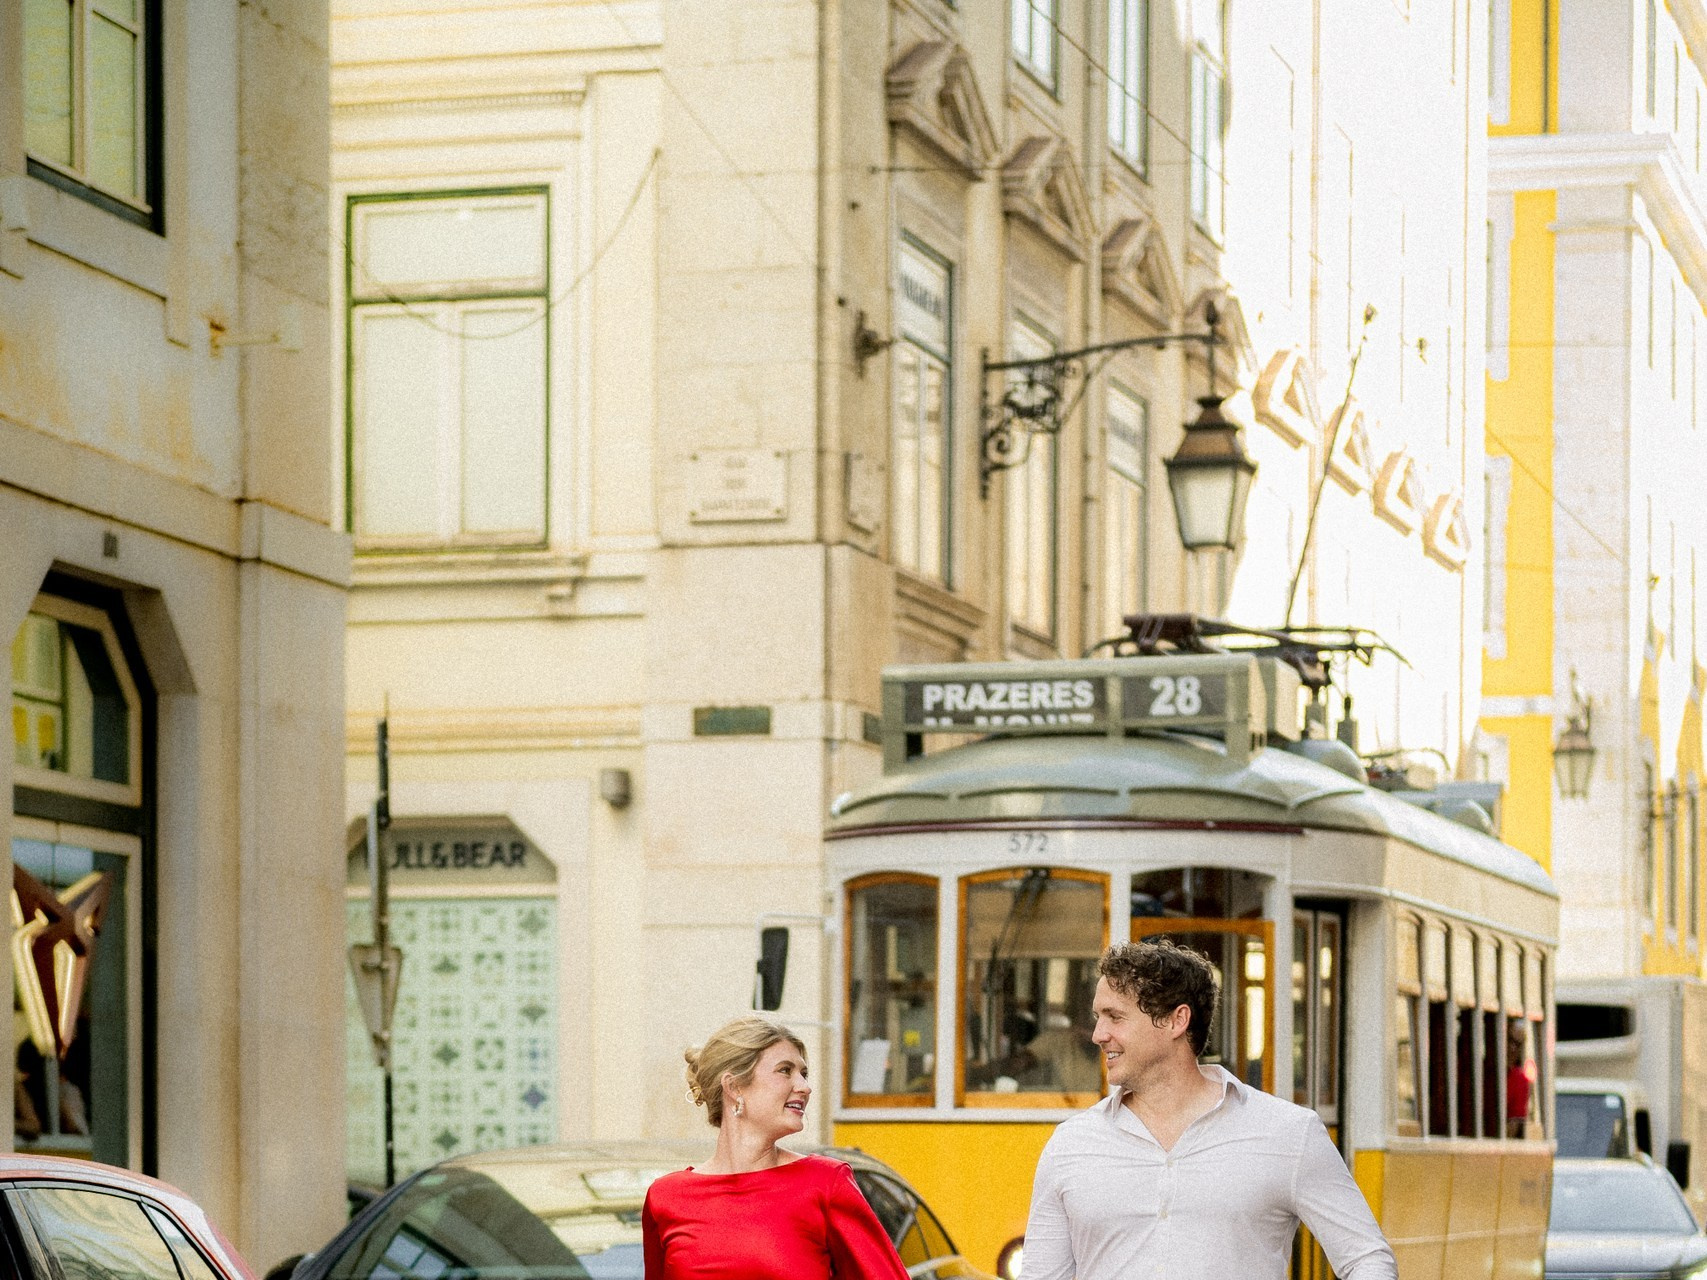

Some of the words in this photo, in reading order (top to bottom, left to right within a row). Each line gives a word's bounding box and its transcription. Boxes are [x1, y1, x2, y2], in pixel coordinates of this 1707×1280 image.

[922, 680, 1095, 711] PRAZERES
[1149, 676, 1201, 716] 28
[1009, 832, 1049, 854] 572
